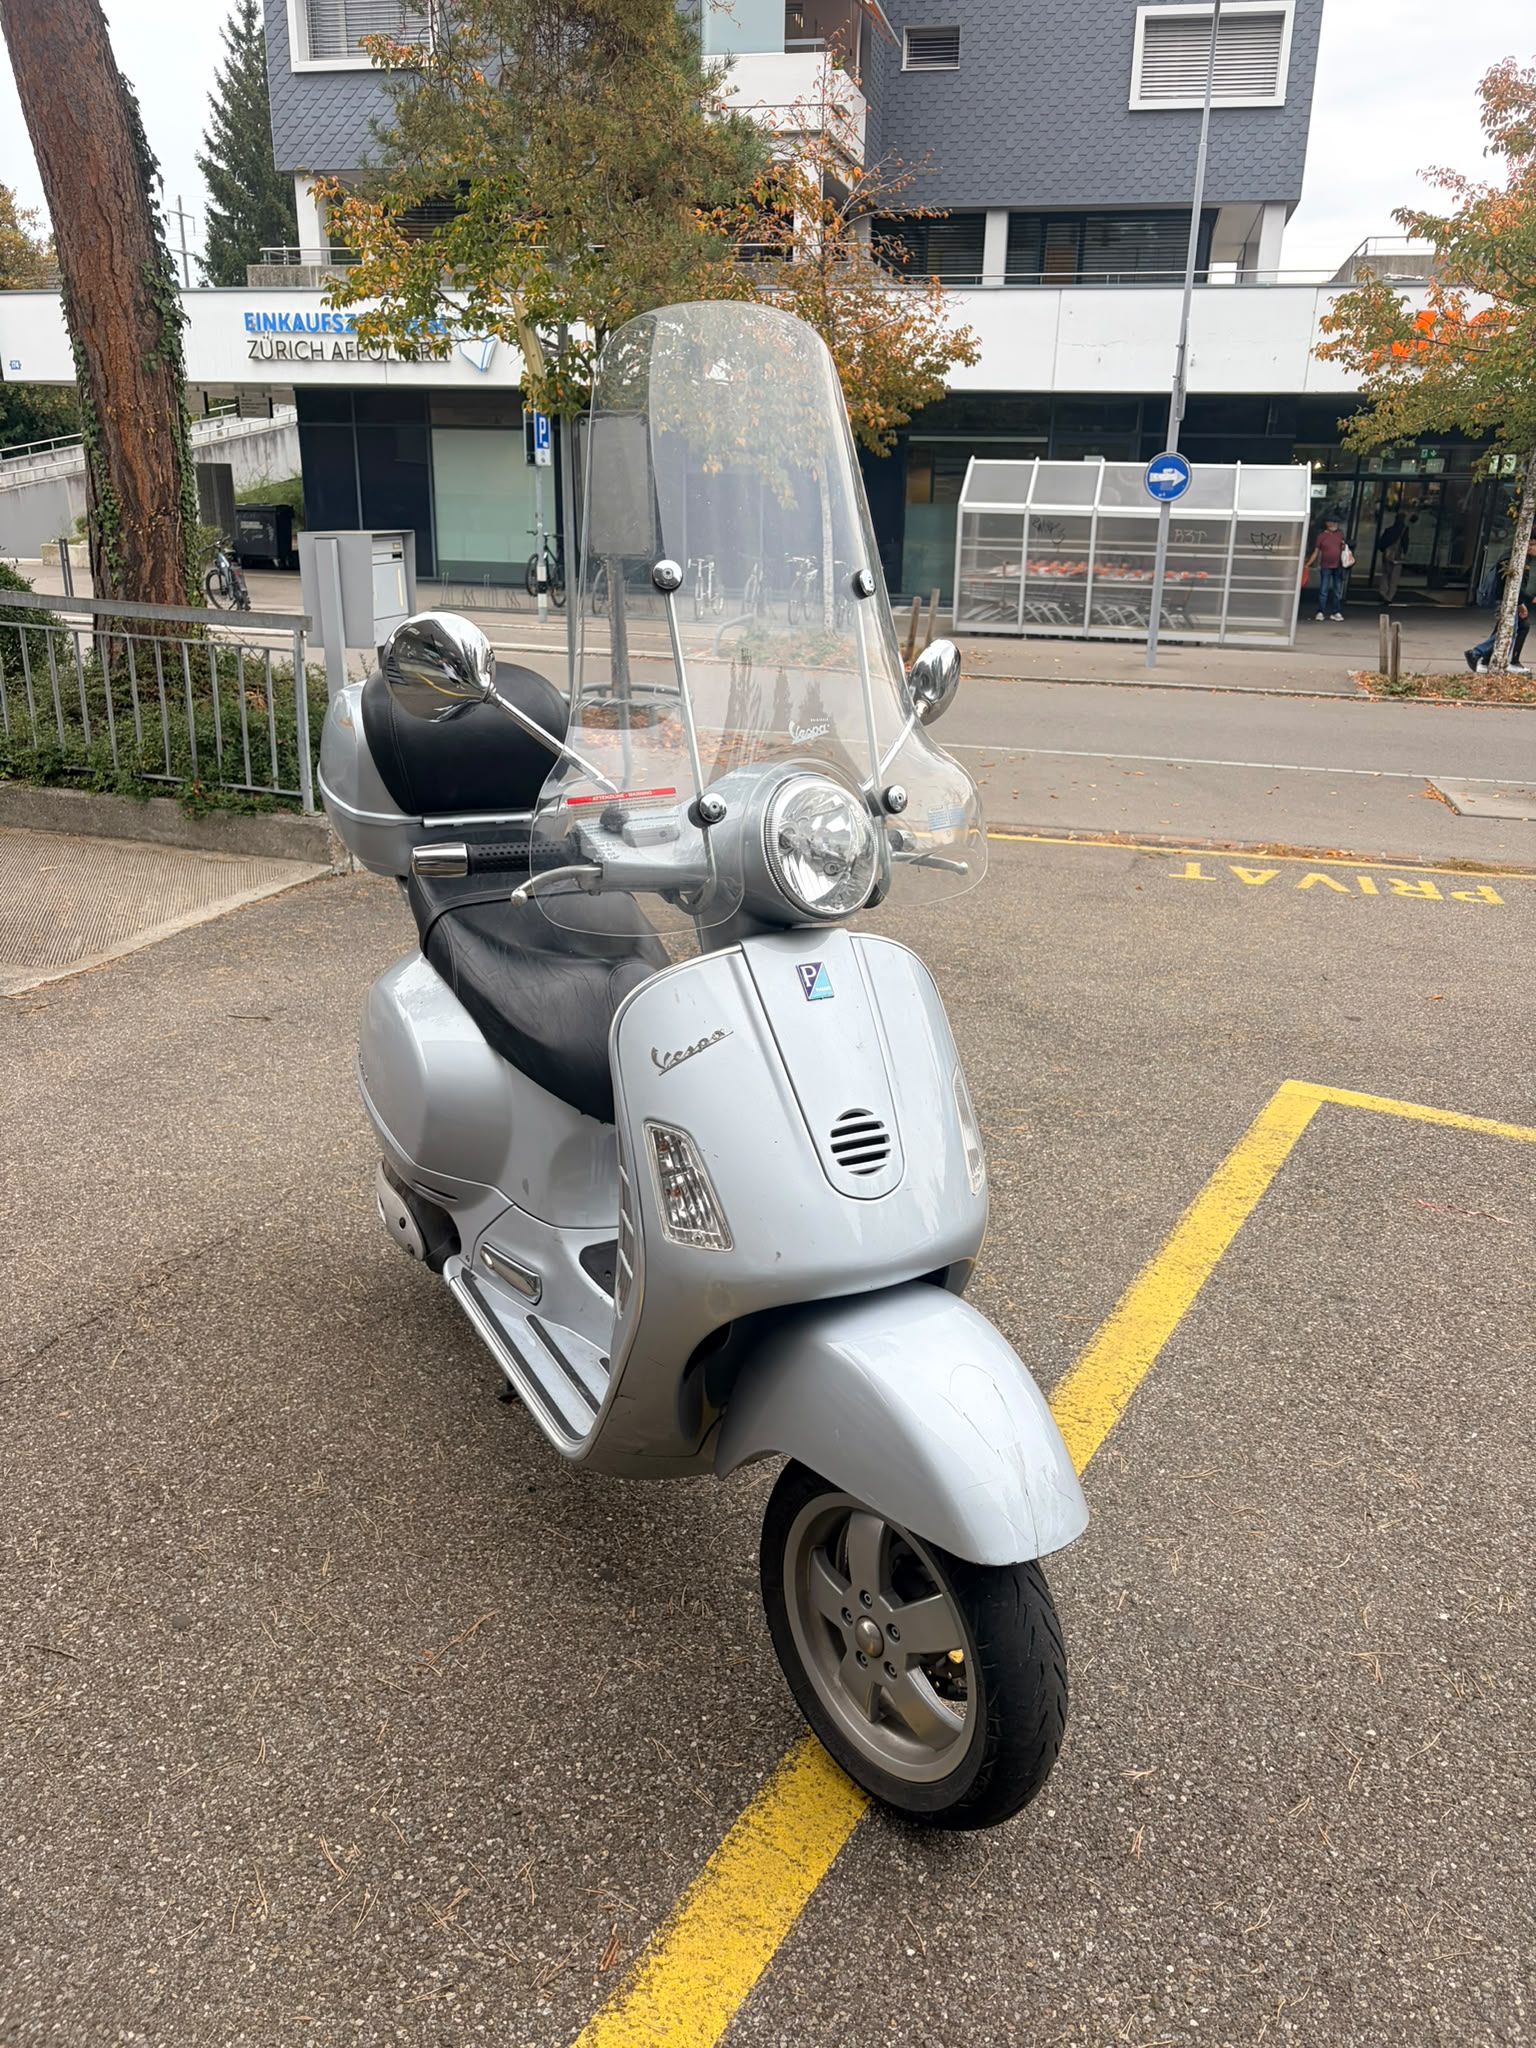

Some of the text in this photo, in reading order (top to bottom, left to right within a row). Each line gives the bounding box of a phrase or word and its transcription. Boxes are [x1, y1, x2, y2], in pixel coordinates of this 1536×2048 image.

[243, 312, 448, 334] EINKAUFSZ
[246, 335, 449, 361] ZÜRICH AFFOLR
[539, 416, 547, 445] P
[788, 719, 830, 745] Vespa
[1168, 861, 1505, 905] PRIVAT
[799, 964, 817, 988] P
[650, 1028, 735, 1077] Vespa
